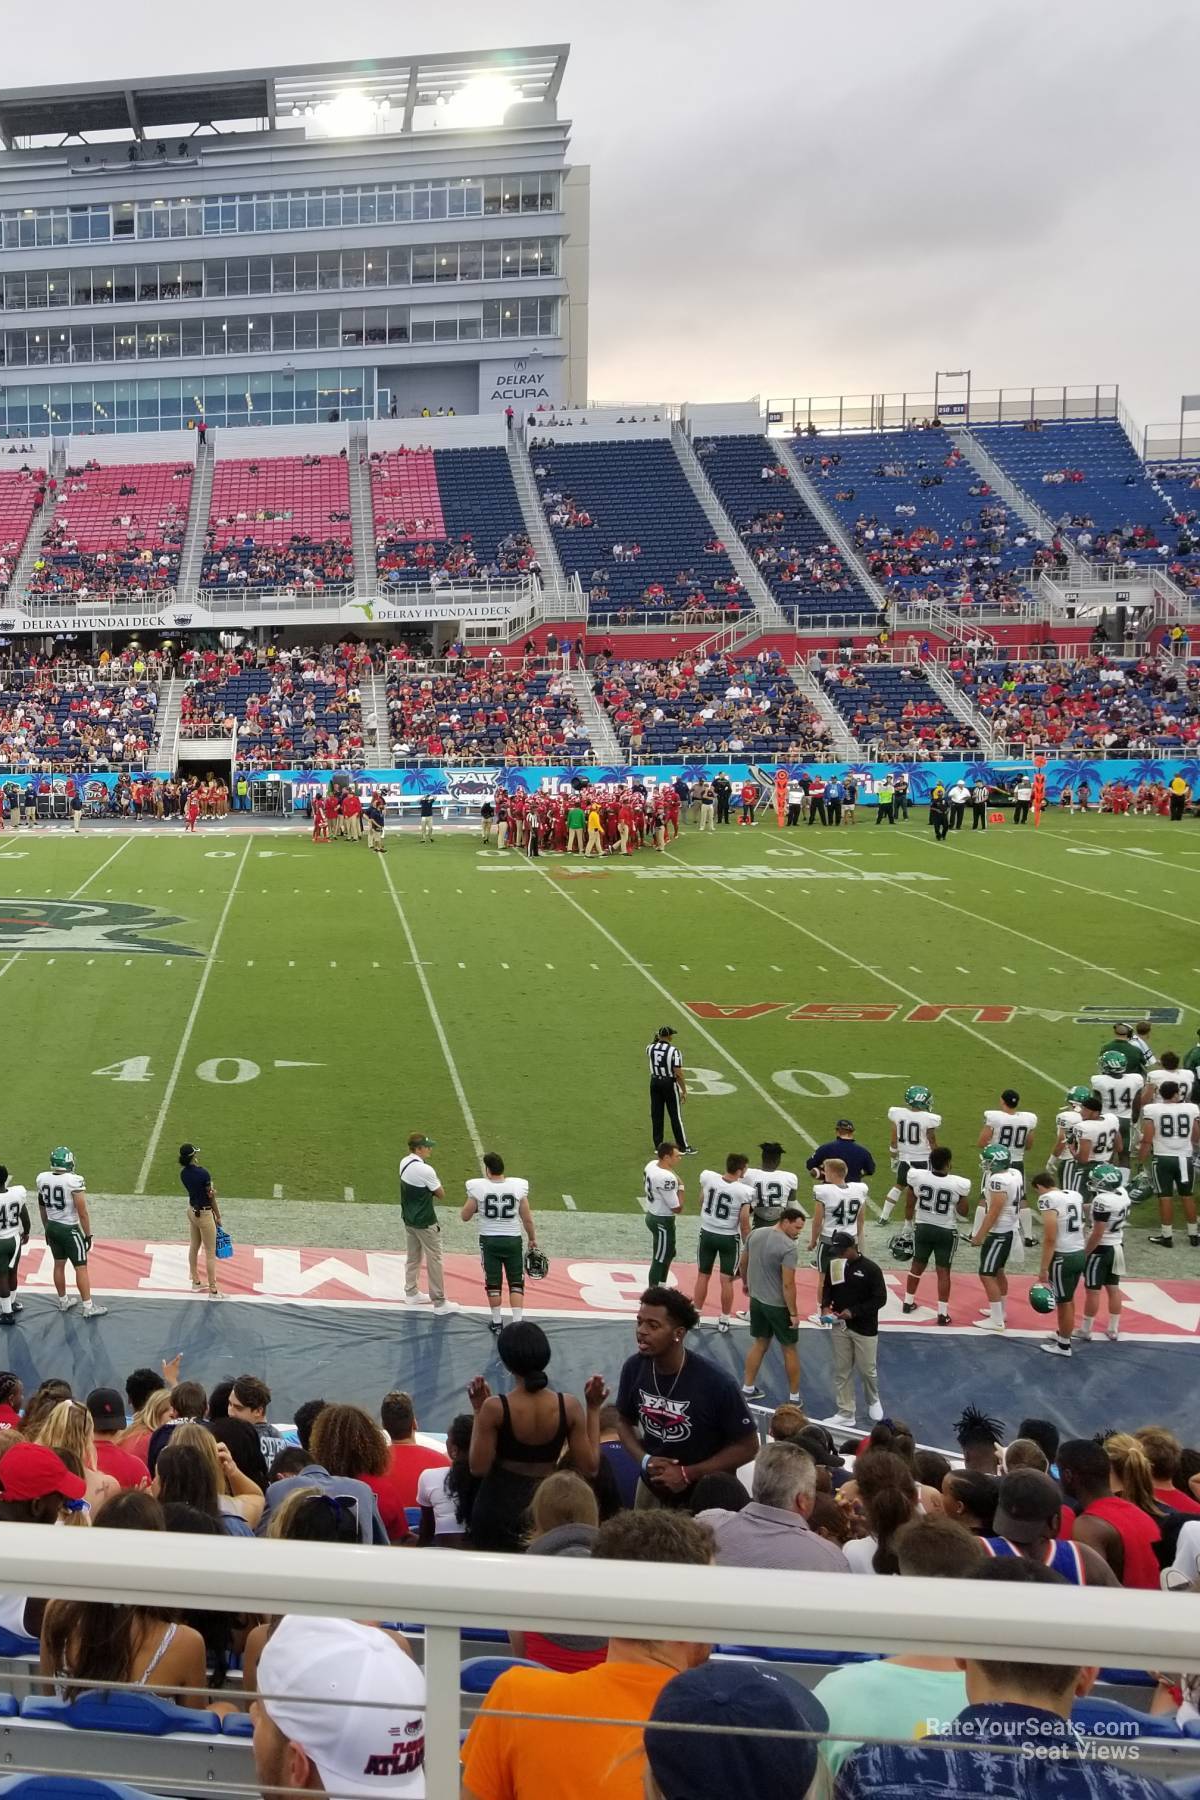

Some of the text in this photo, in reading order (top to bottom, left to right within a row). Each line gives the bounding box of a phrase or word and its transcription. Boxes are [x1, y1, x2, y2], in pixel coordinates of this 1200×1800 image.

[497, 374, 544, 386] DELRAY
[491, 388, 549, 400] ACURA
[22, 619, 70, 630] DELRAY
[72, 617, 130, 629] HYUNDAI
[132, 616, 166, 627] DECK
[377, 606, 512, 620] DELRAY HYUNDAI DECK
[91, 1055, 261, 1084] 40
[653, 1050, 665, 1067] F
[1107, 1087, 1132, 1110] 14
[898, 1120, 920, 1145] 10
[999, 1125, 1028, 1149] 80
[1160, 1114, 1191, 1138] 88
[1093, 1129, 1118, 1154] 83
[41, 1184, 66, 1211] 39
[663, 1180, 676, 1191] 23
[755, 1182, 783, 1208] 12
[484, 1193, 516, 1219] 62
[704, 1188, 732, 1221] 16
[831, 1199, 861, 1225] 49
[918, 1185, 951, 1215] 28
[642, 1393, 691, 1416] FAU
